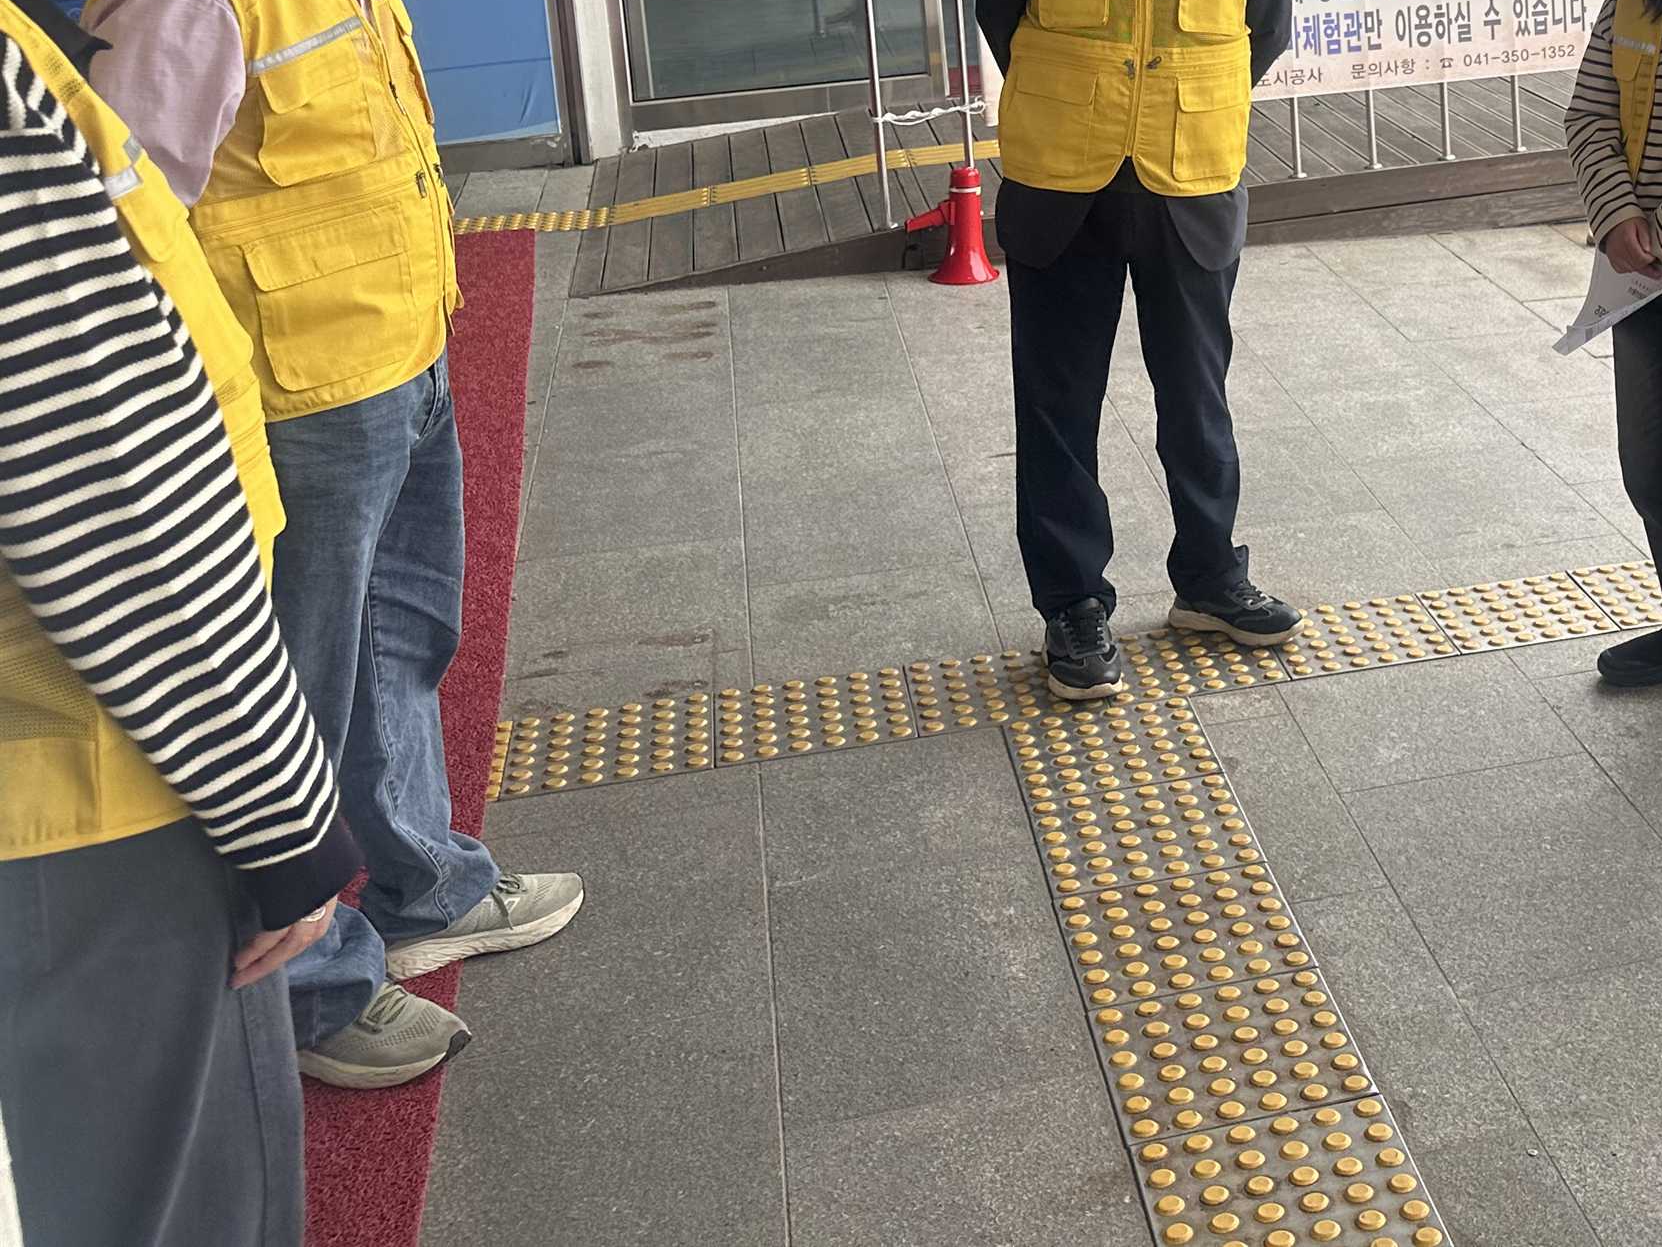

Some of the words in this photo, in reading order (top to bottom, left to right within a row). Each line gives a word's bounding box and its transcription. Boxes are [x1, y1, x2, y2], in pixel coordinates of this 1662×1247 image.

[1395, 0, 1472, 48] 이용하실
[1483, 0, 1502, 40] 수
[1351, 58, 1416, 80] 문의사항
[1463, 44, 1576, 67] 041-350-1352
